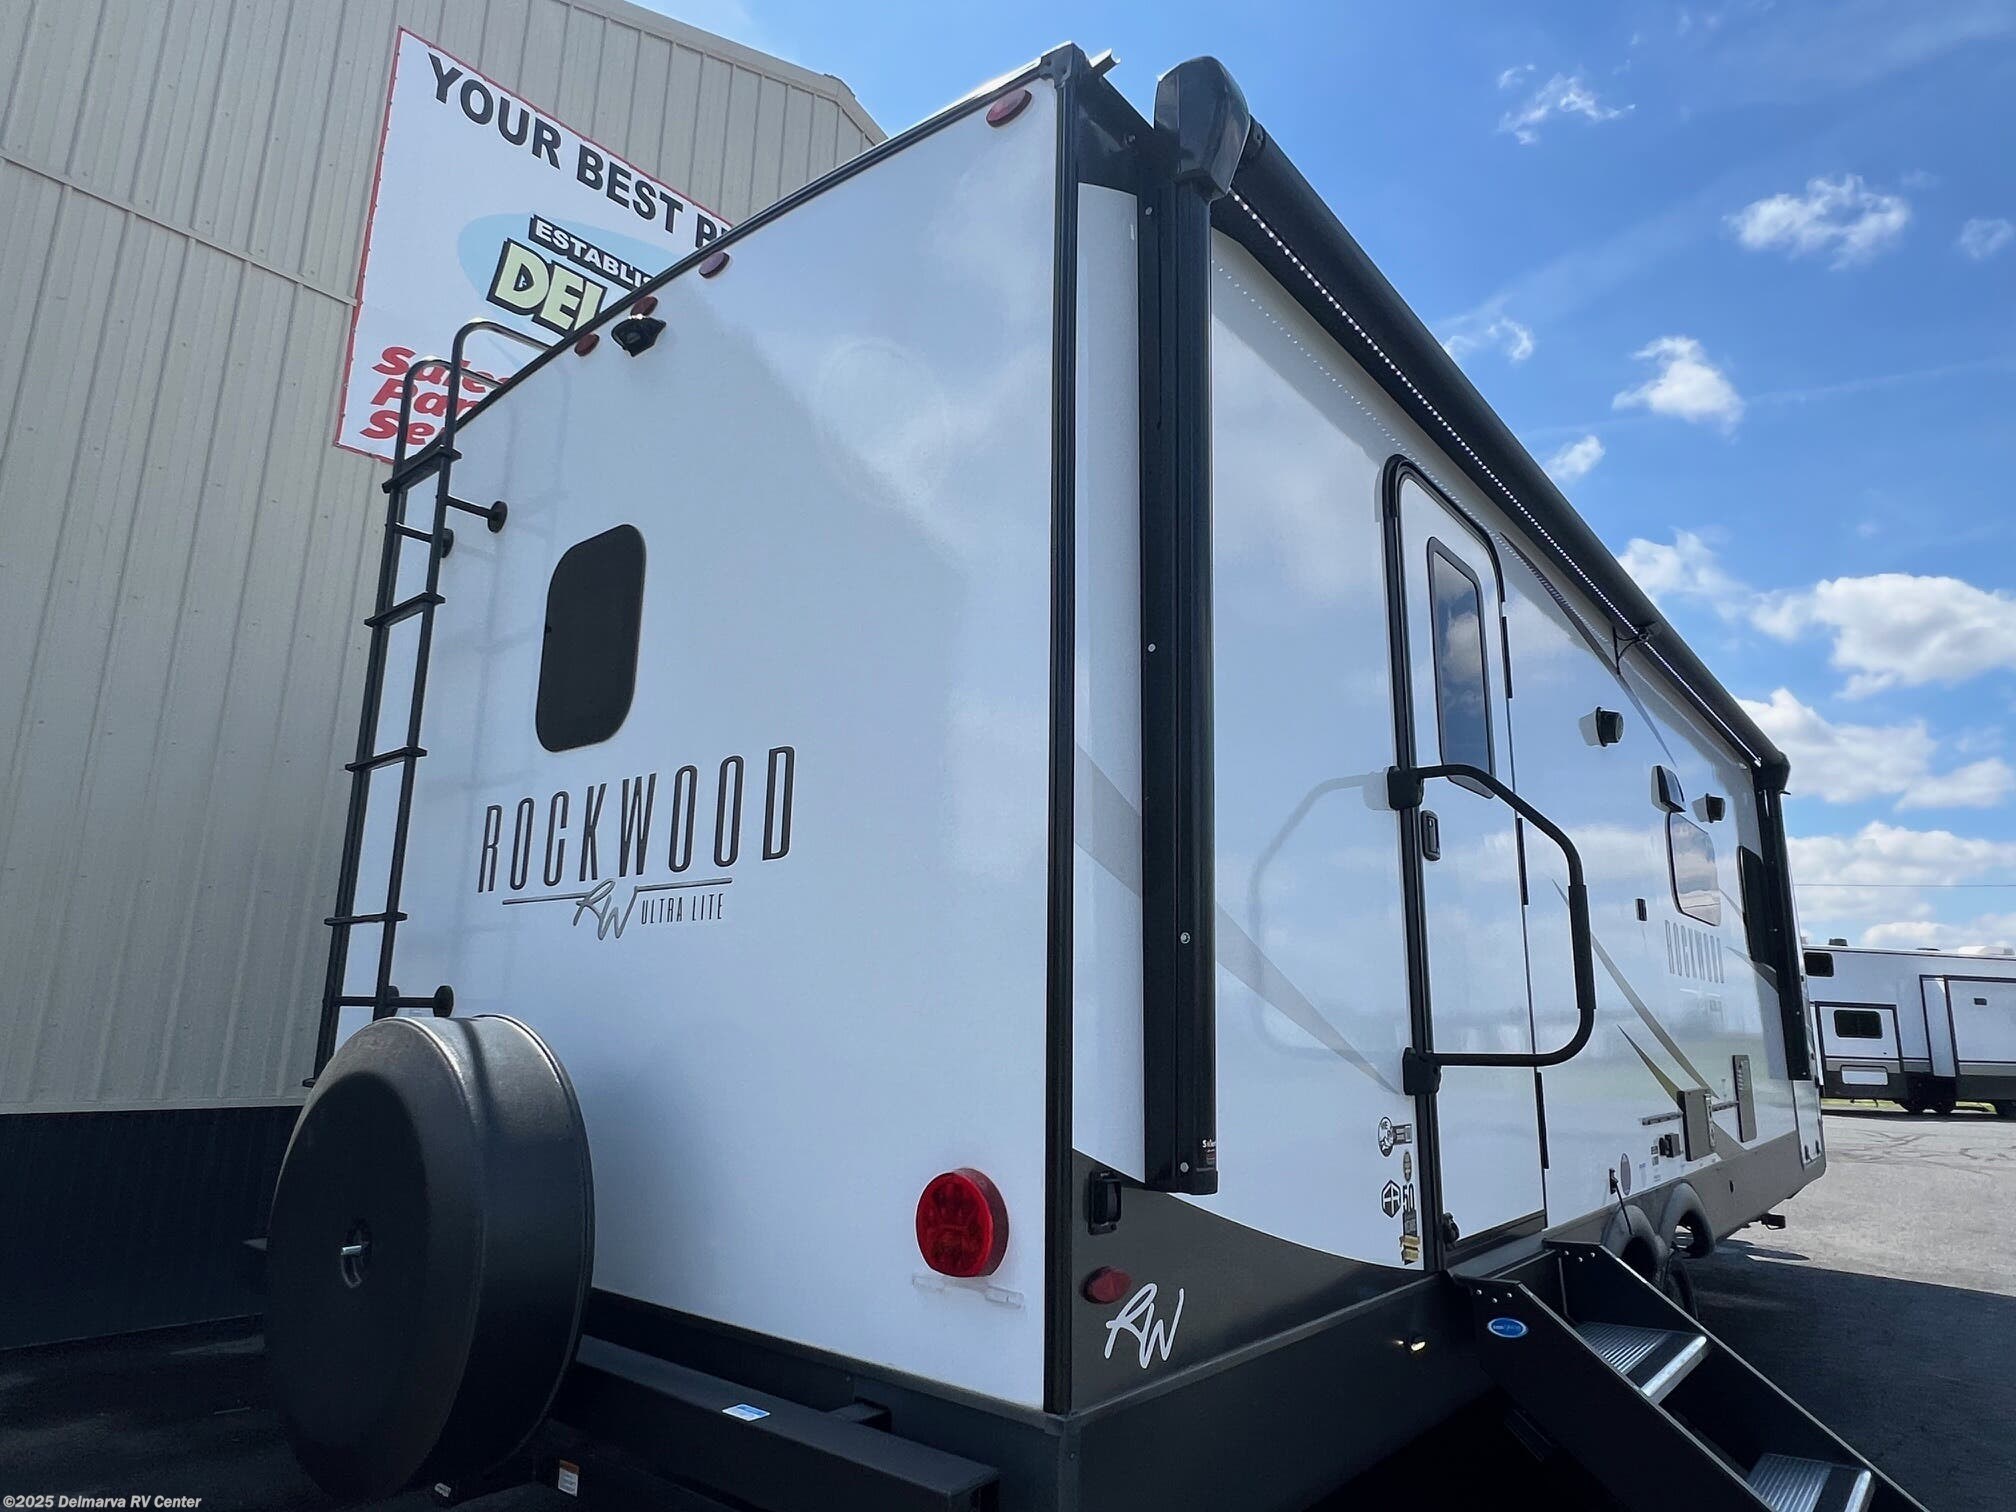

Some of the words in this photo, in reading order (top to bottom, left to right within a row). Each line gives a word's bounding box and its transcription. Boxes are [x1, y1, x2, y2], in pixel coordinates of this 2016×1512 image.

[428, 53, 561, 170] YOUR
[577, 144, 683, 233] BEST
[695, 213, 728, 249] P
[478, 746, 795, 893] ROCKWOOD
[641, 897, 683, 925] ULTRA
[692, 893, 724, 921] LITE
